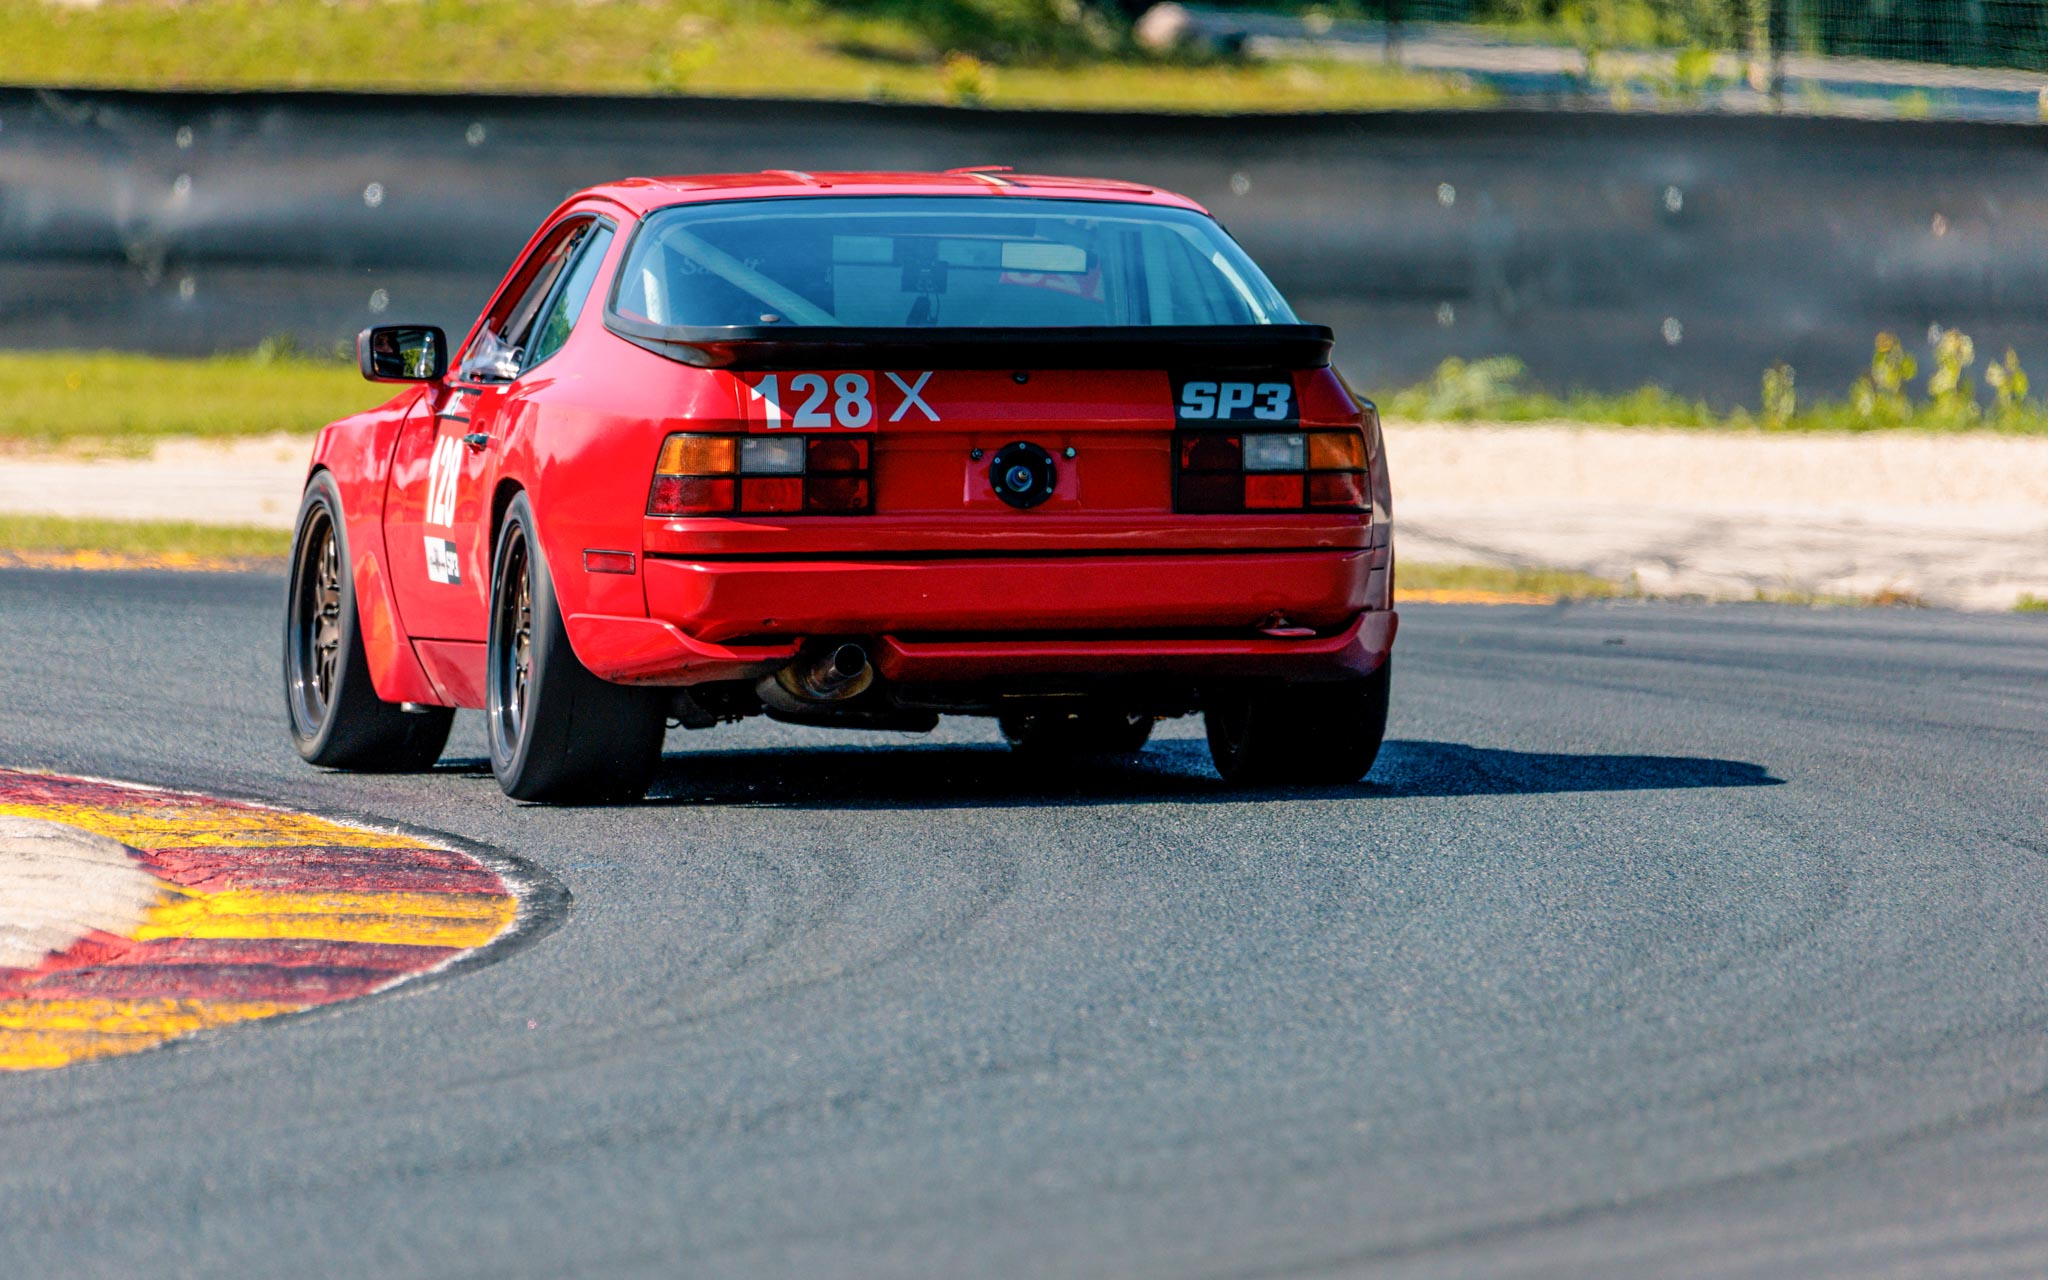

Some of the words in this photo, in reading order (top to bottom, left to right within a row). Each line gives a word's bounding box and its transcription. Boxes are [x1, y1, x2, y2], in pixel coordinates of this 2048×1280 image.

[750, 373, 873, 429] 128
[884, 371, 941, 423] X
[1179, 381, 1291, 420] SP3
[426, 434, 463, 528] 128
